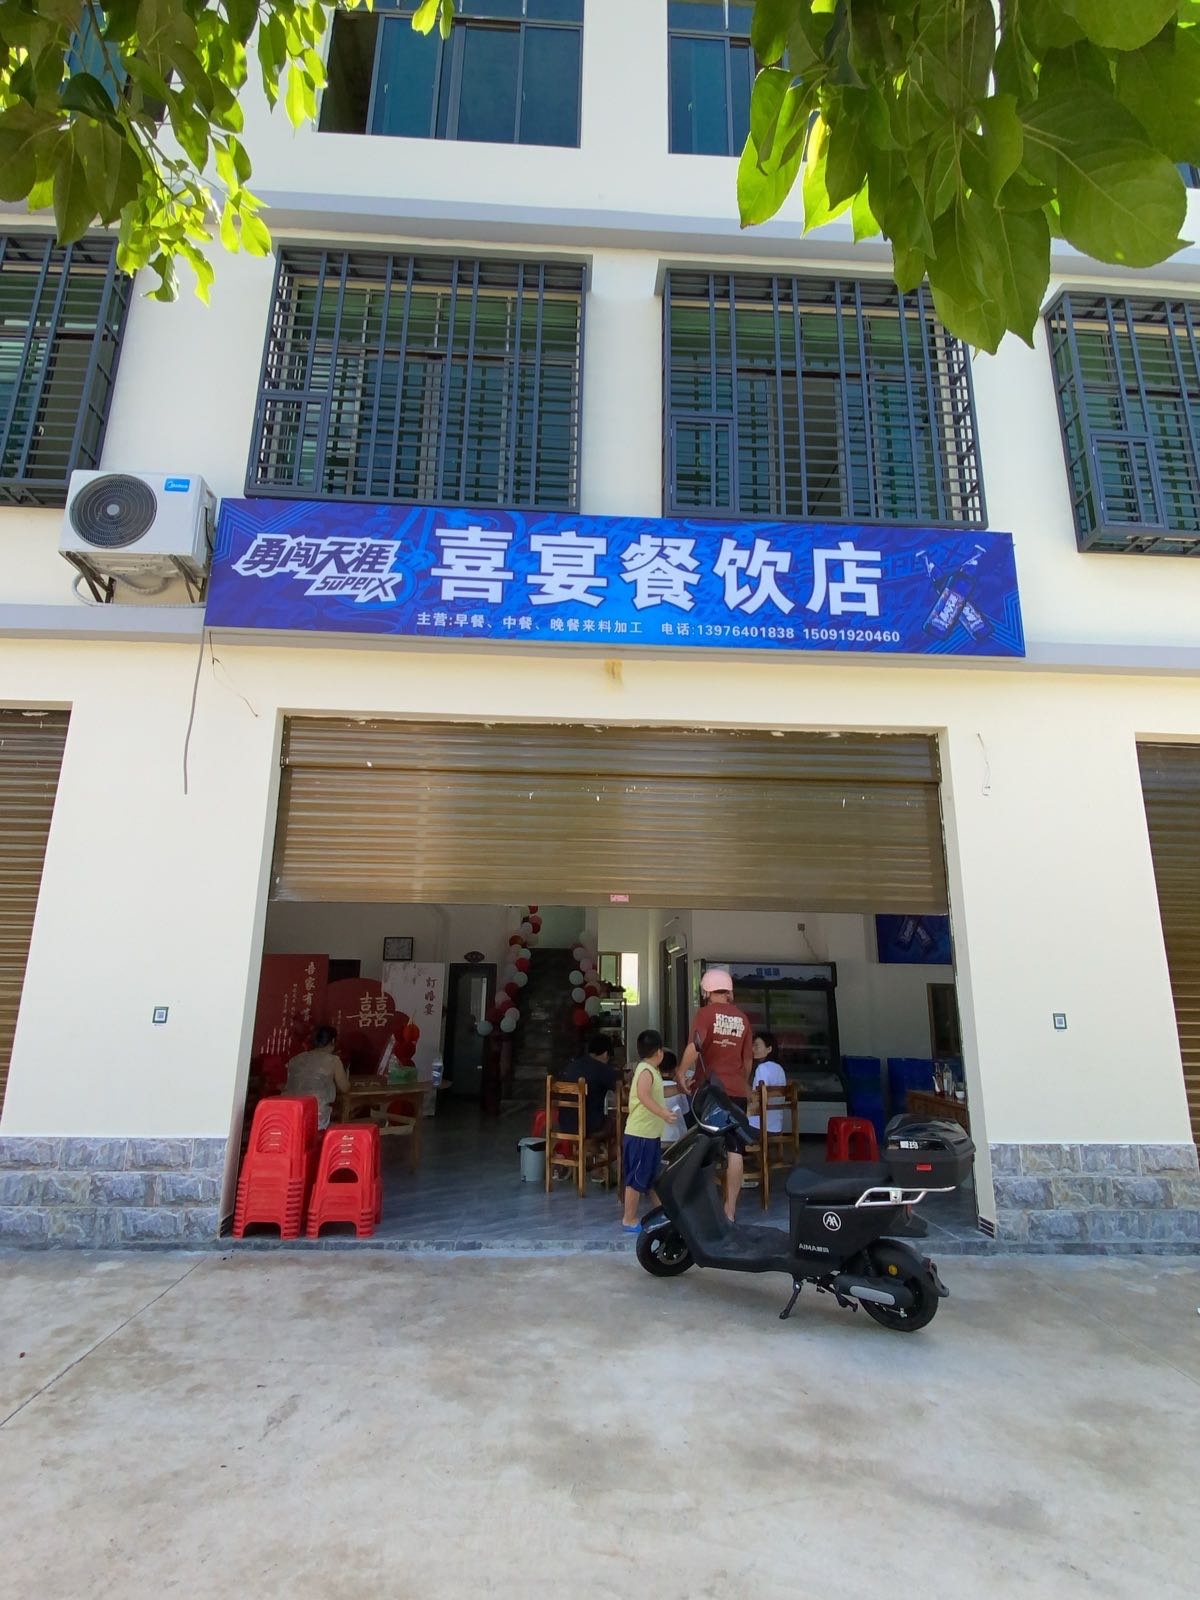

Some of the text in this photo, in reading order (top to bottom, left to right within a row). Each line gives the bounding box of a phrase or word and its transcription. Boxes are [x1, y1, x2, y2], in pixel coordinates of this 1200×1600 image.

[234, 535, 397, 577] 勇闯天涯
[430, 525, 882, 617] 喜宴餐饮店
[802, 628, 900, 642] 15091920460
